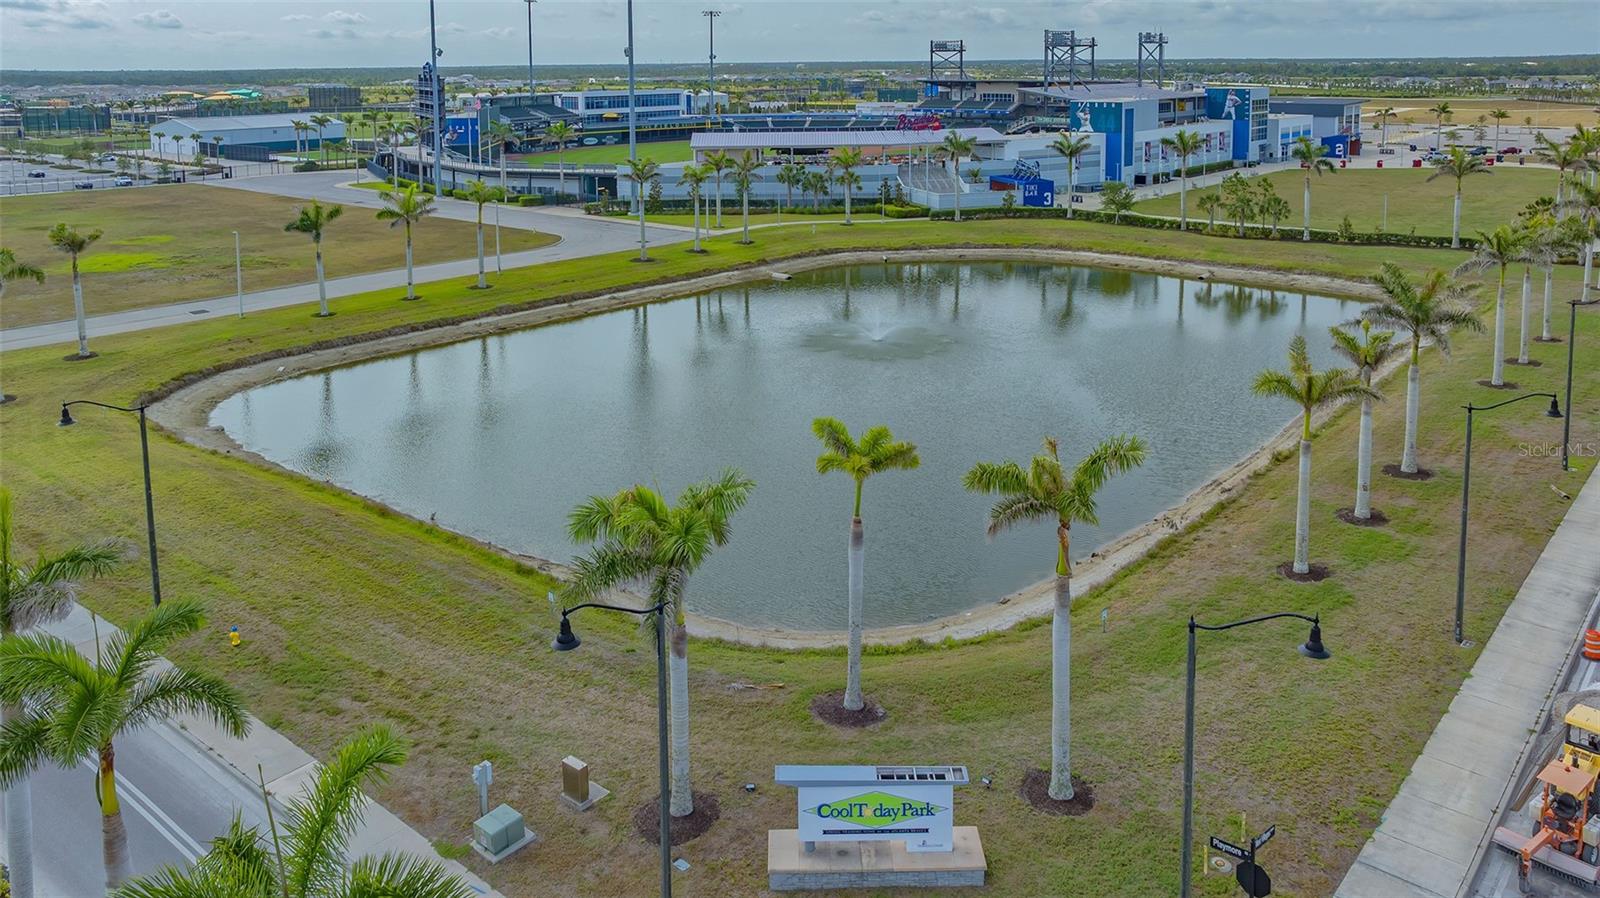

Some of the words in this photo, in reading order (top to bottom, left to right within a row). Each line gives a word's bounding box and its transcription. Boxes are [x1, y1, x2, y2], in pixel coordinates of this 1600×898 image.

[1335, 143, 1344, 155] 2
[1043, 192, 1052, 205] 3
[902, 802, 935, 817] Park
[1212, 838, 1242, 856] Playmore
